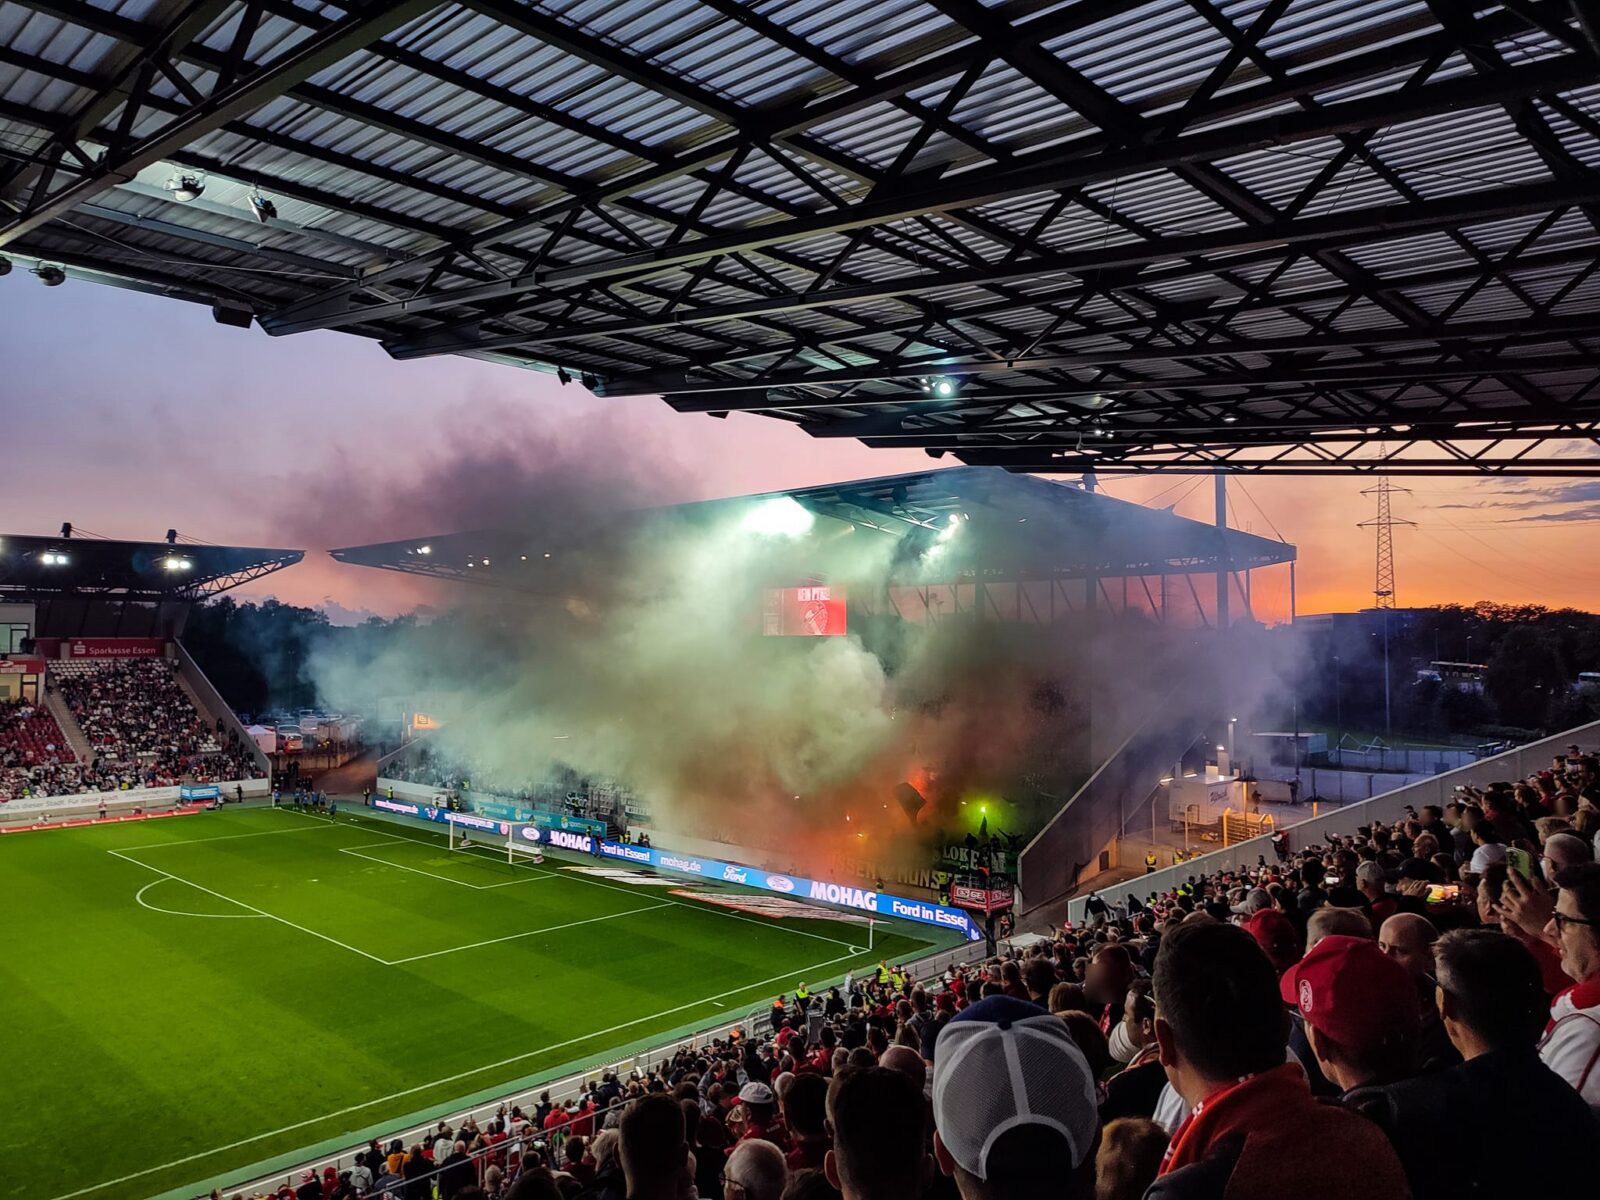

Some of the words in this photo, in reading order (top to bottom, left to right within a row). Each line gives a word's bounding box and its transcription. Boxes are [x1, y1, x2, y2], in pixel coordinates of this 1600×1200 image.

[89, 647, 131, 656] Sparkasse
[132, 646, 156, 655] Essen
[550, 830, 591, 852] MOHAG
[600, 842, 617, 855] Ford
[616, 845, 625, 856] in
[625, 847, 650, 862] Essen!
[660, 856, 701, 872] mohag.de
[723, 865, 747, 883] Ford
[810, 881, 878, 912] MOHAG
[892, 900, 920, 918] Ford
[921, 906, 934, 921] in
